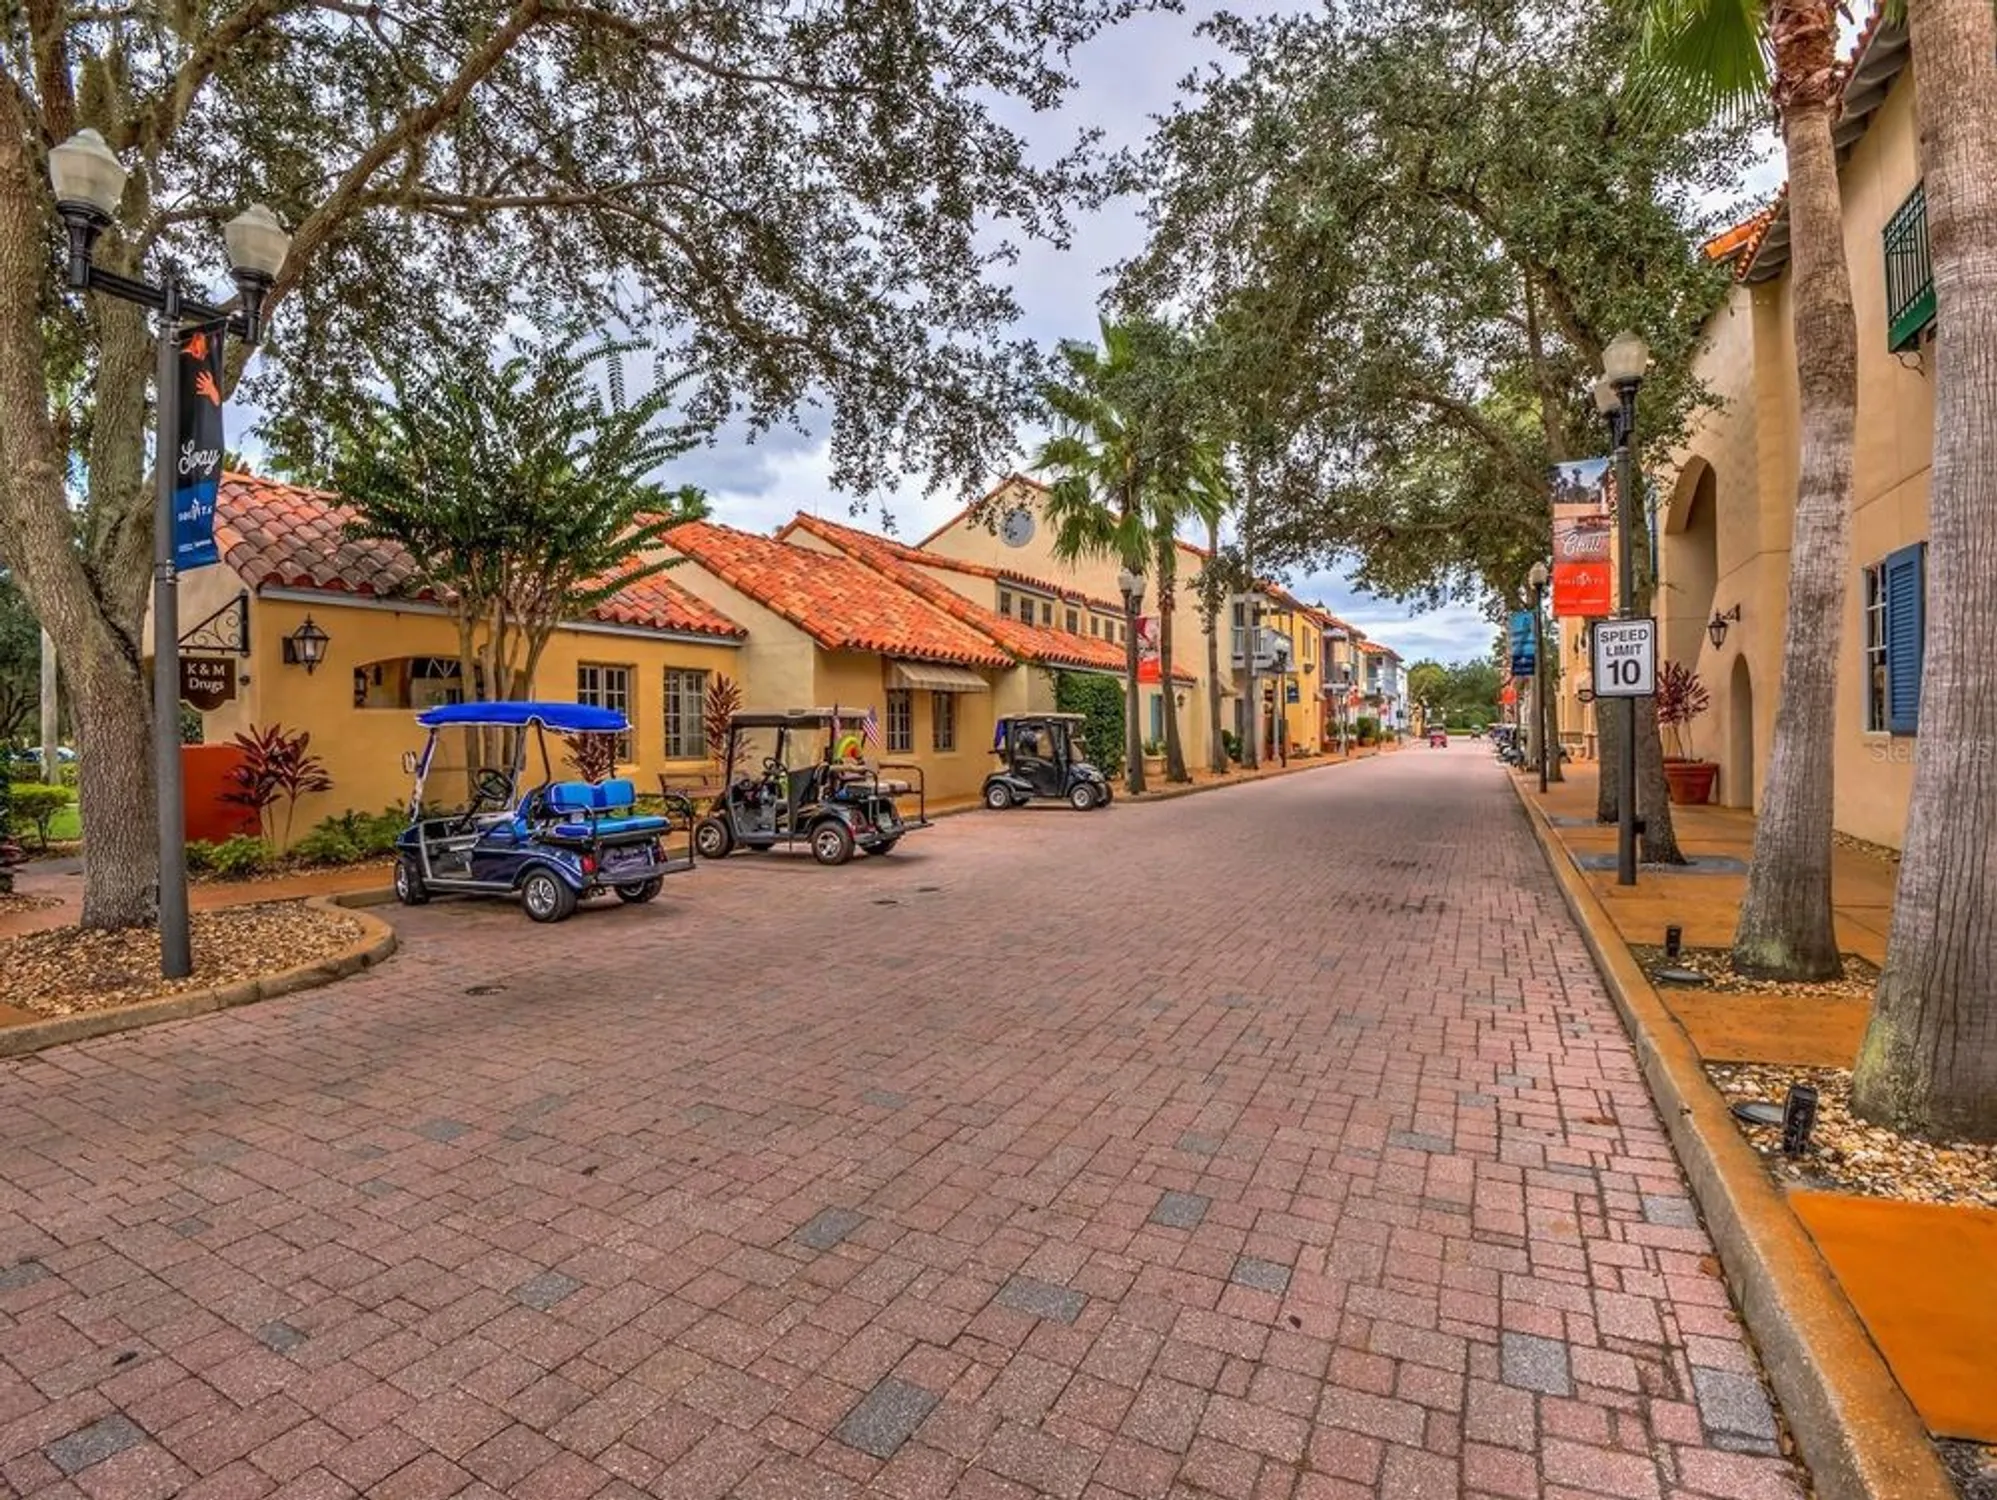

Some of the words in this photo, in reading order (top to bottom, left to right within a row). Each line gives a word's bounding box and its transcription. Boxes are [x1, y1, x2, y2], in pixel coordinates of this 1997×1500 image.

[1600, 629, 1649, 643] SPEED
[1606, 643, 1643, 657] LIMIT
[187, 663, 197, 675] K
[199, 663, 210, 676] &
[212, 664, 225, 676] M
[1606, 658, 1641, 685] 10
[189, 677, 225, 694] Drugs
